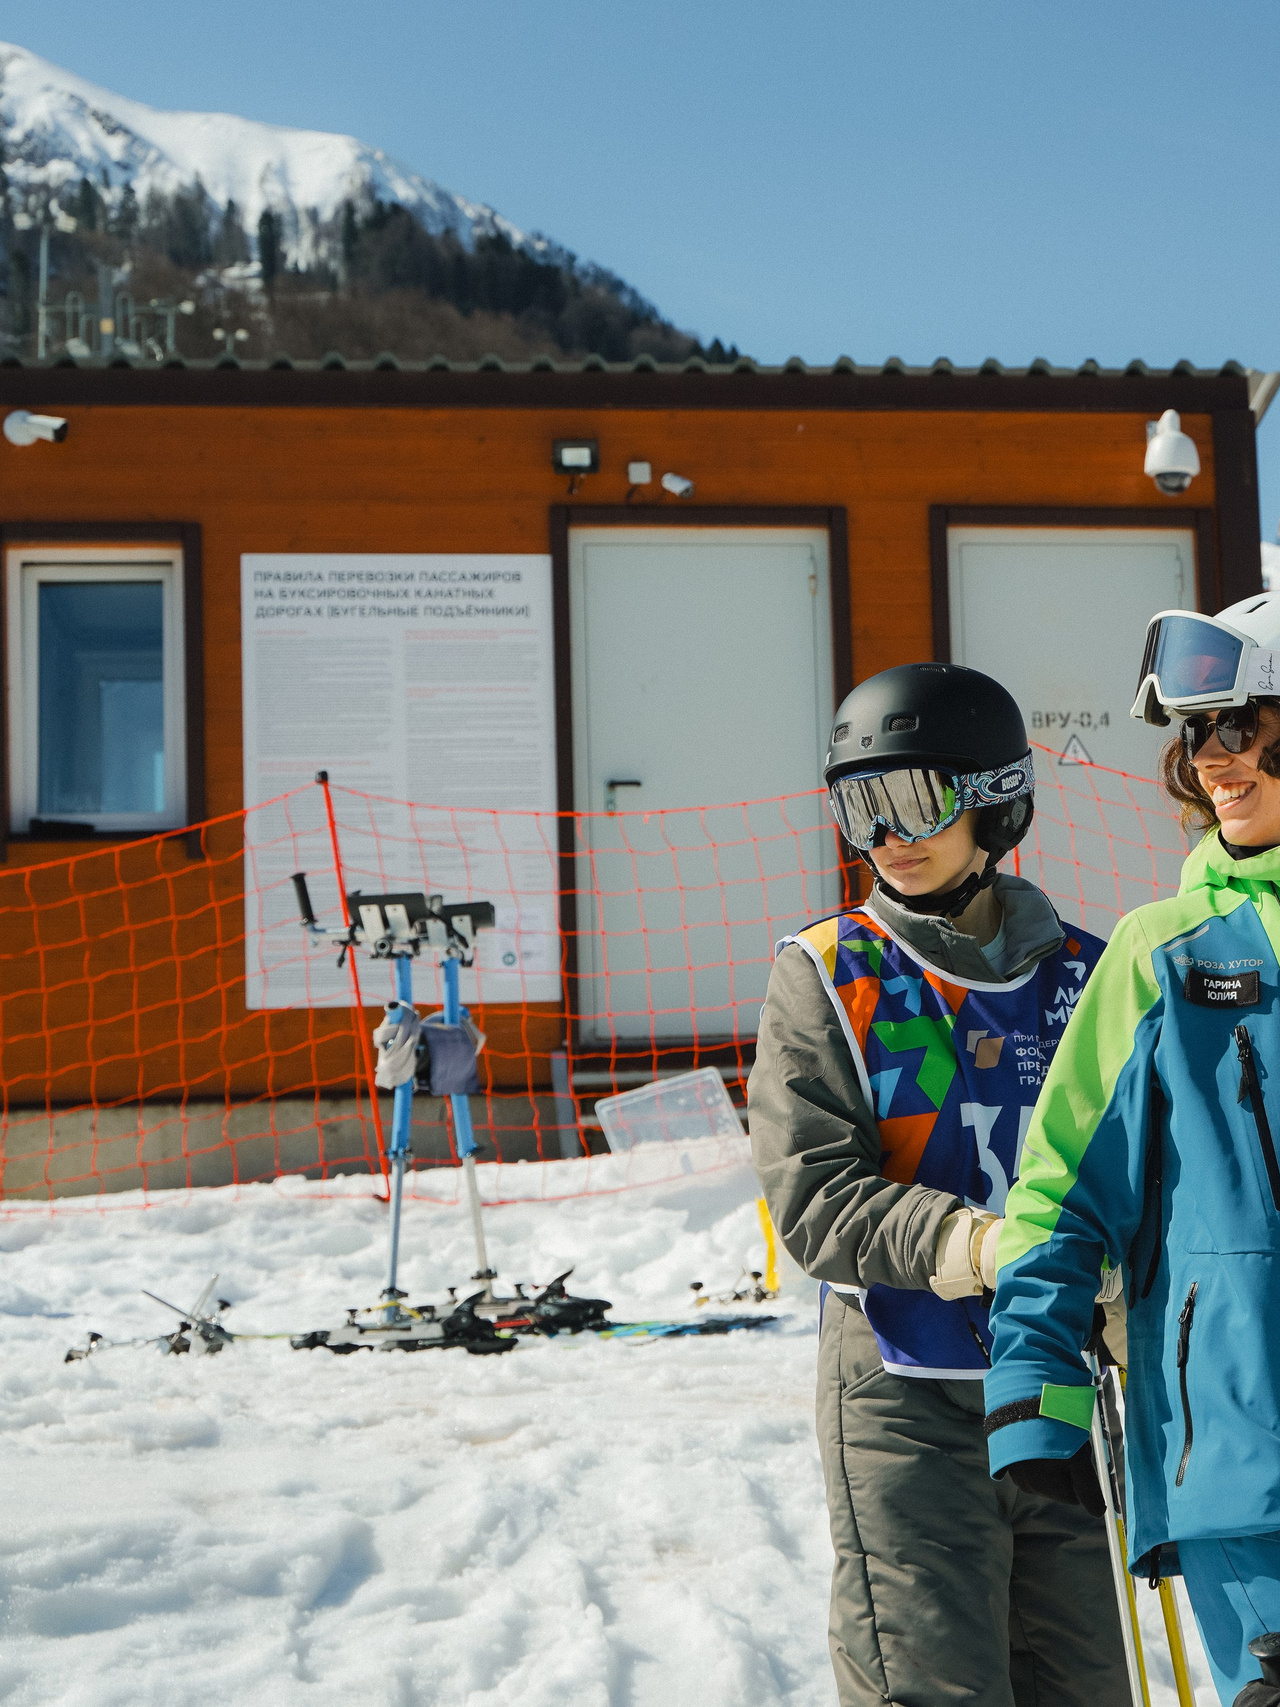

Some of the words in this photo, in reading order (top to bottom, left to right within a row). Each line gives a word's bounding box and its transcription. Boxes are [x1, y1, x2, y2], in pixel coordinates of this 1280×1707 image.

[254, 570, 323, 582] ПРАВИЛА
[328, 570, 415, 583] ПЕРЕВОЗКИ
[419, 571, 523, 583] ПАССАЖИРОВ
[254, 588, 274, 599] НА
[414, 588, 495, 599] КАНАТНЫХ
[255, 605, 323, 619] ДОРОГАХ
[1197, 959, 1225, 970] РОЗА
[1228, 958, 1264, 970] ХУТОР
[1203, 978, 1242, 990] ГАРИНА
[1207, 991, 1238, 1001] ЮЛИЯ
[1013, 1035, 1035, 1043] ПРИ
